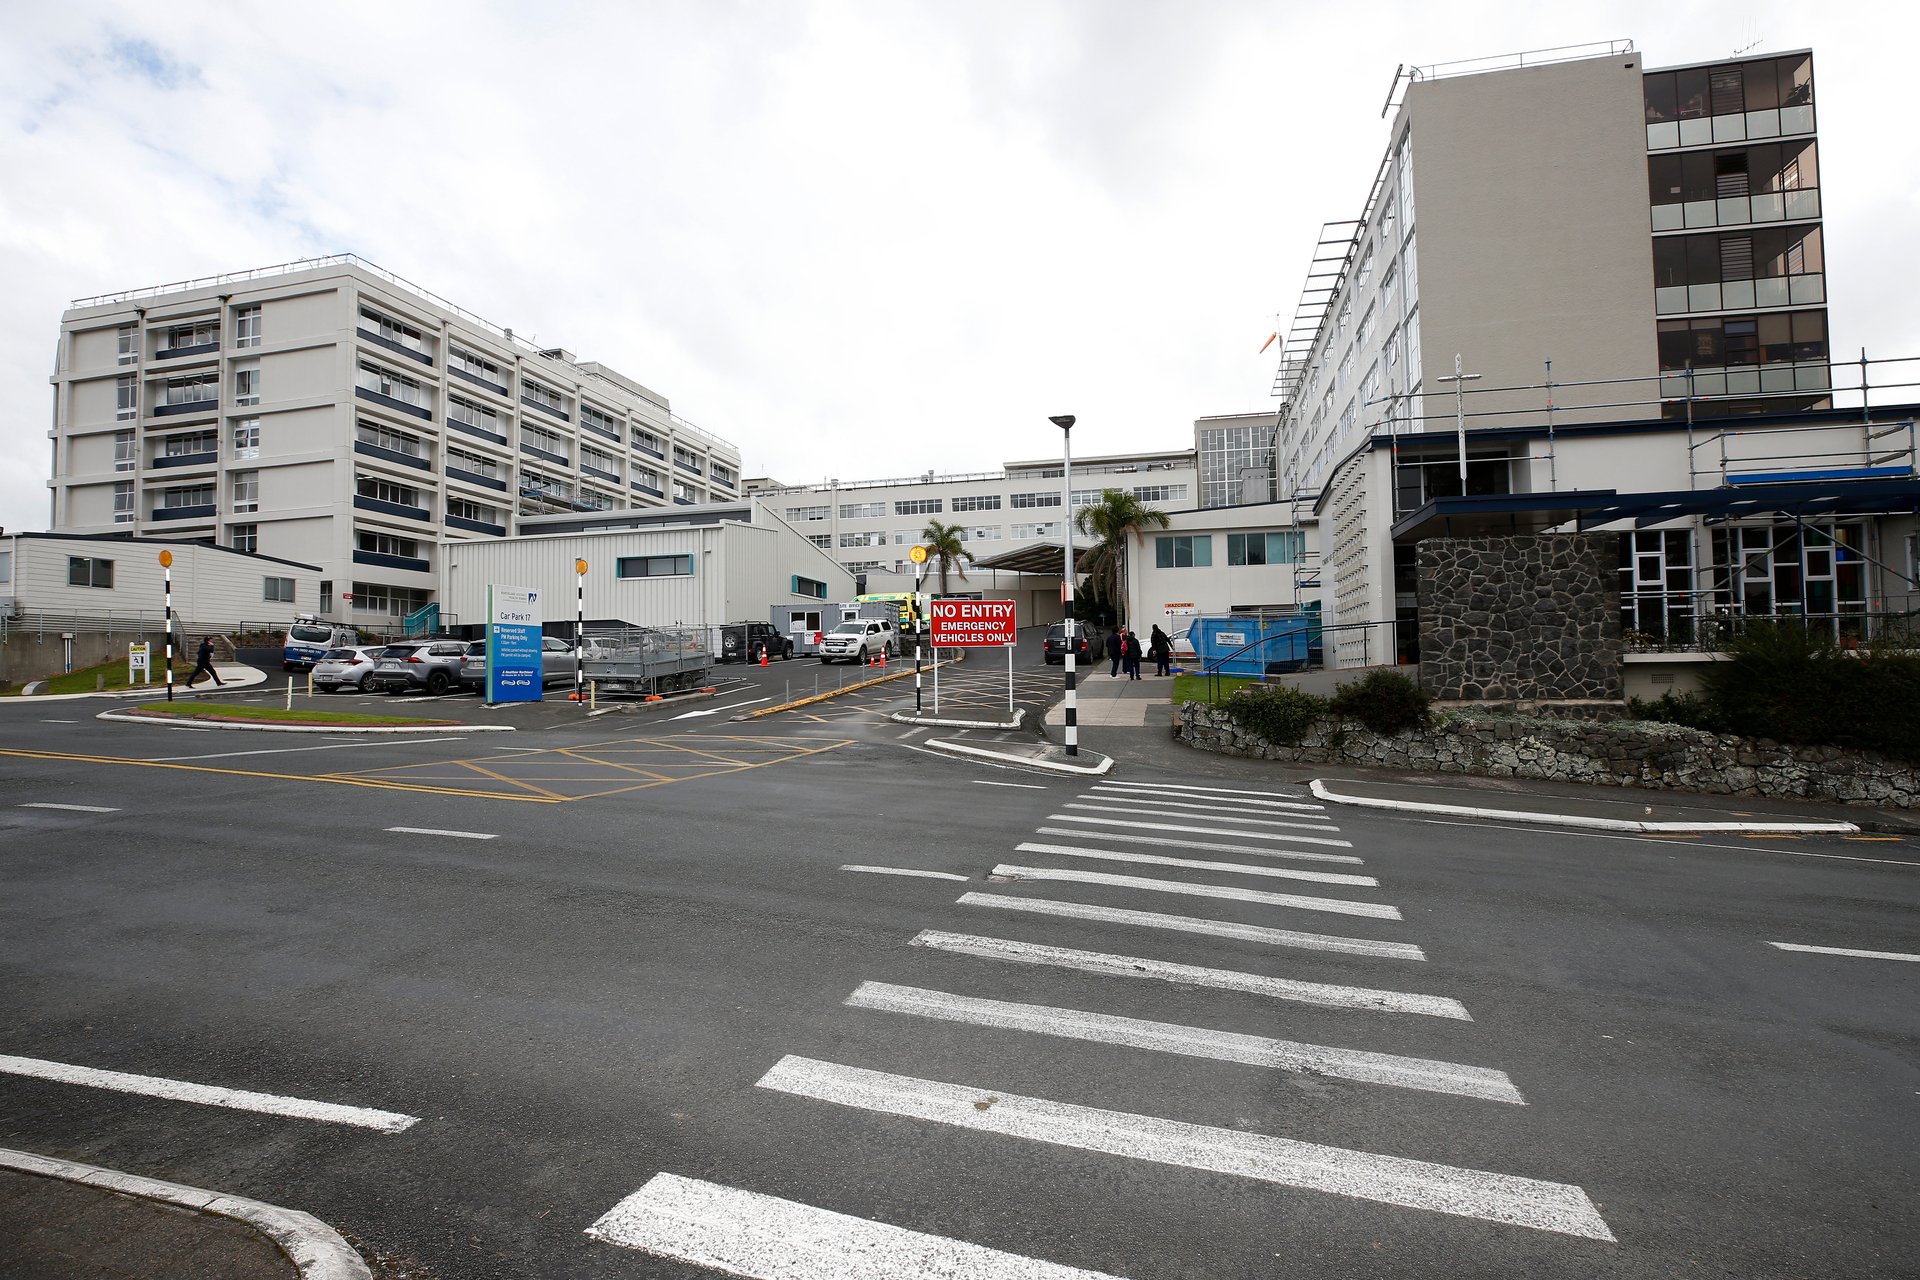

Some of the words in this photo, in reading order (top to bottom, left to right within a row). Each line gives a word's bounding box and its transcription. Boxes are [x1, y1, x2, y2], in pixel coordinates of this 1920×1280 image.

[501, 611, 510, 620] Car
[511, 612, 525, 621] Park
[932, 604, 957, 618] NO
[961, 604, 1014, 618] ENTRY
[941, 621, 1006, 631] EMERGENCY
[933, 633, 984, 643] VEHICLES
[986, 633, 1014, 642] ONLY
